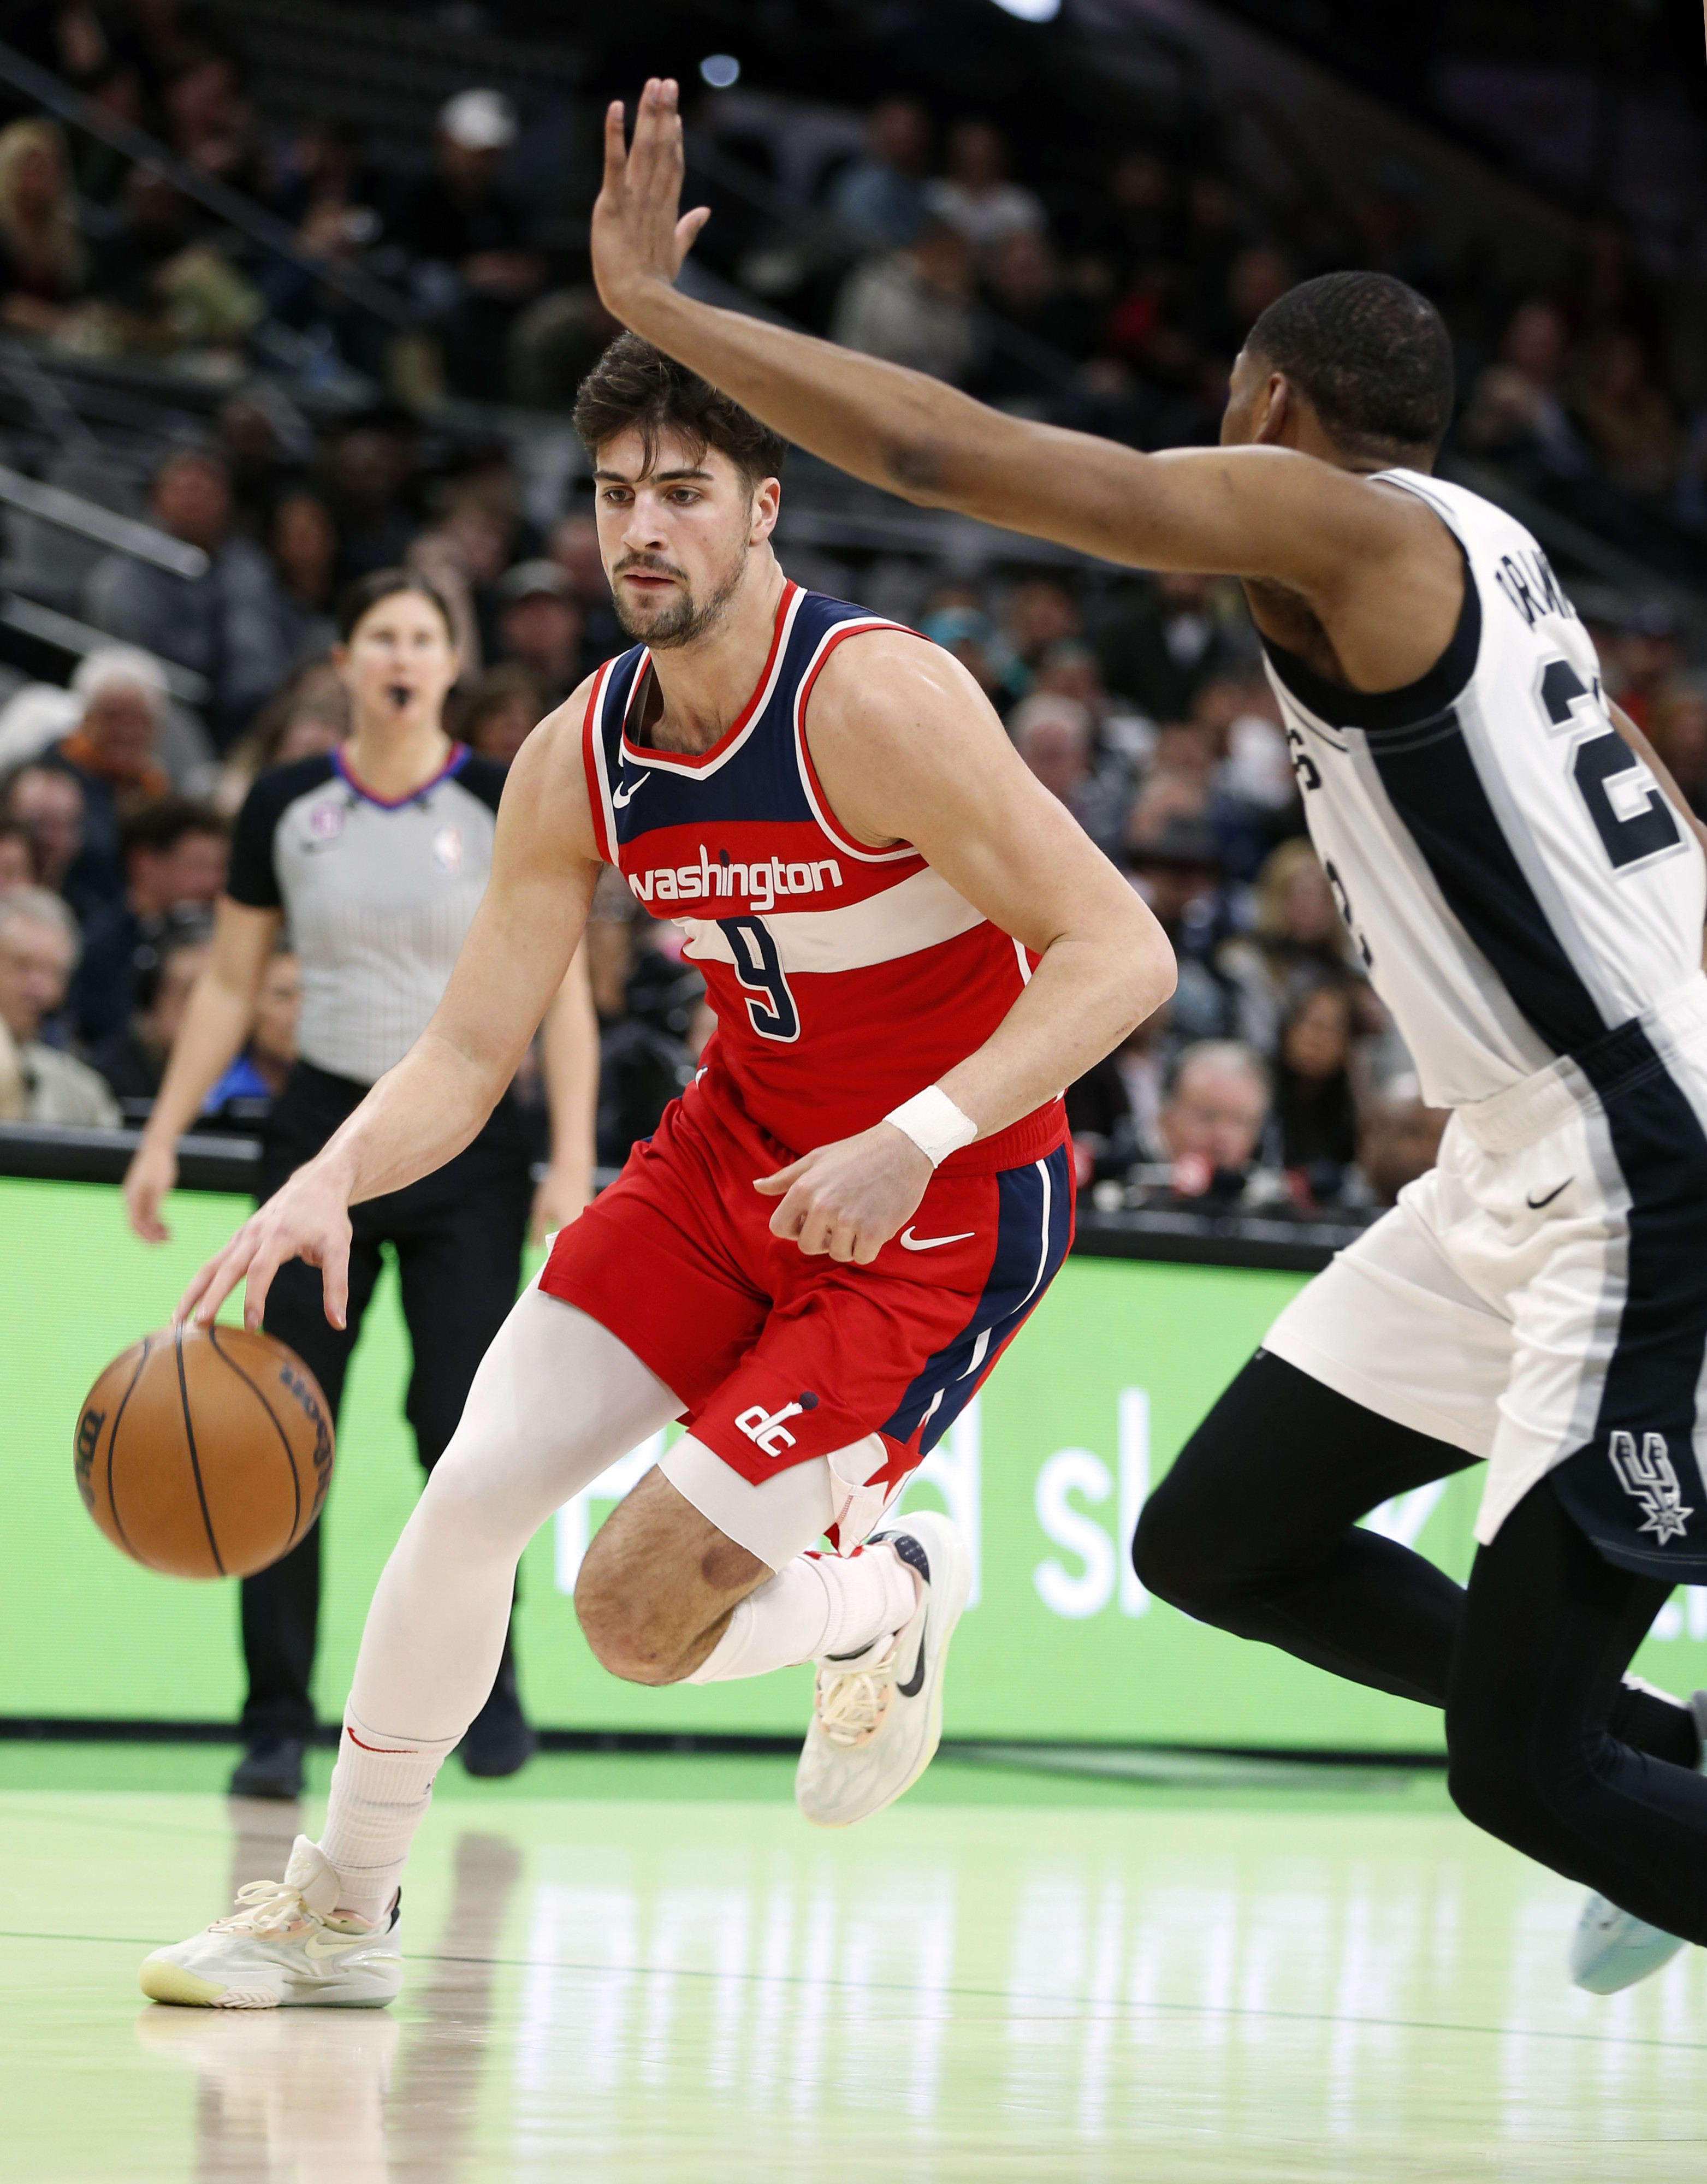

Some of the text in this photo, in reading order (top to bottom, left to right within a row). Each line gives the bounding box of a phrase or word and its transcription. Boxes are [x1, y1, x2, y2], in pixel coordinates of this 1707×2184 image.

[628, 844, 842, 911] washington
[716, 914, 800, 1043] 9
[734, 1401, 803, 1458] dc
